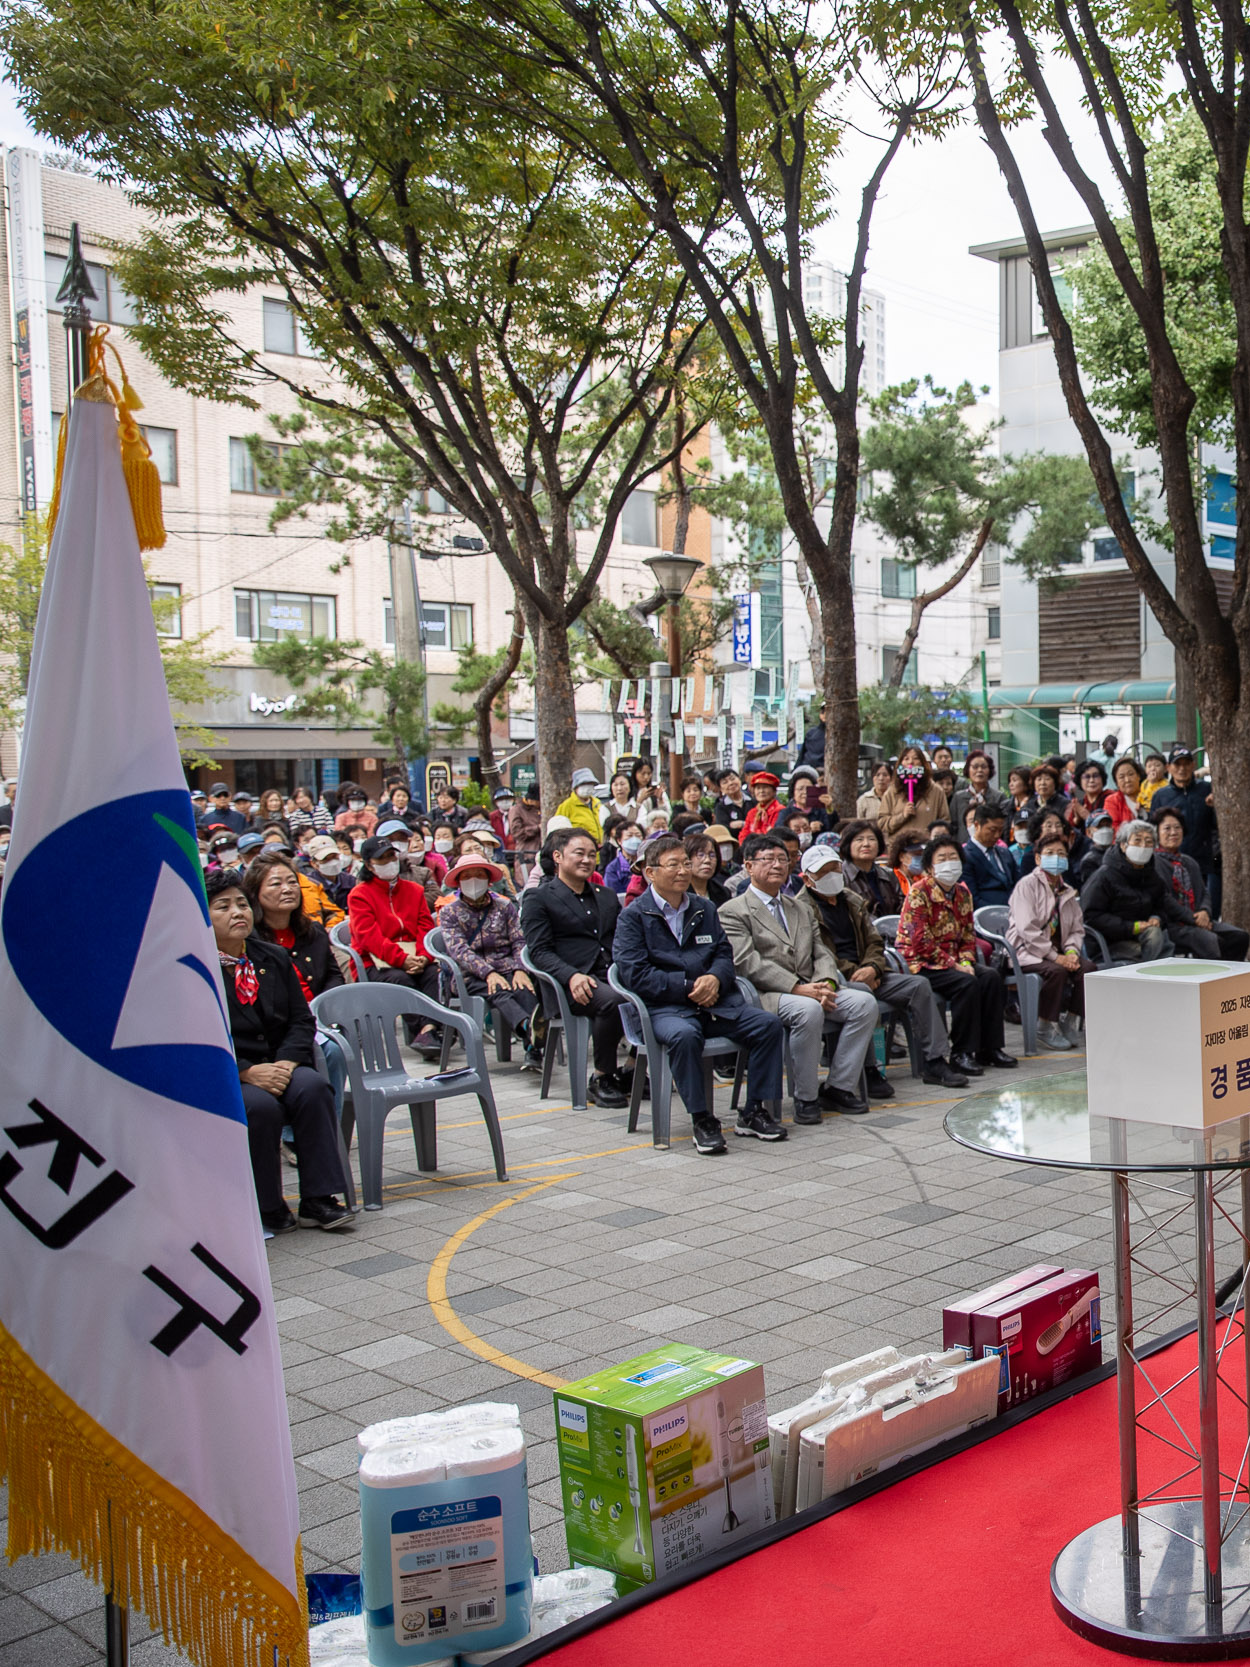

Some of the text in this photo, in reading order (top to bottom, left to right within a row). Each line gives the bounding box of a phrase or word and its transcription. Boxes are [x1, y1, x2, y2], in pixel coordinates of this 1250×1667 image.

[1220, 998, 1237, 1014] 2025
[1205, 1030, 1226, 1047] 자마장
[1228, 1022, 1249, 1041] 어울림
[1002, 1320, 1020, 1332] PHILIPS
[561, 1409, 585, 1423] PHILIPS
[653, 1415, 685, 1436] PHILIPS
[563, 1431, 583, 1443] ProMix
[656, 1441, 682, 1458] ProMix
[417, 1501, 478, 1522] 순수 소프트
[673, 1524, 695, 1542] 다양한
[664, 1532, 702, 1559] 요리를 더욱
